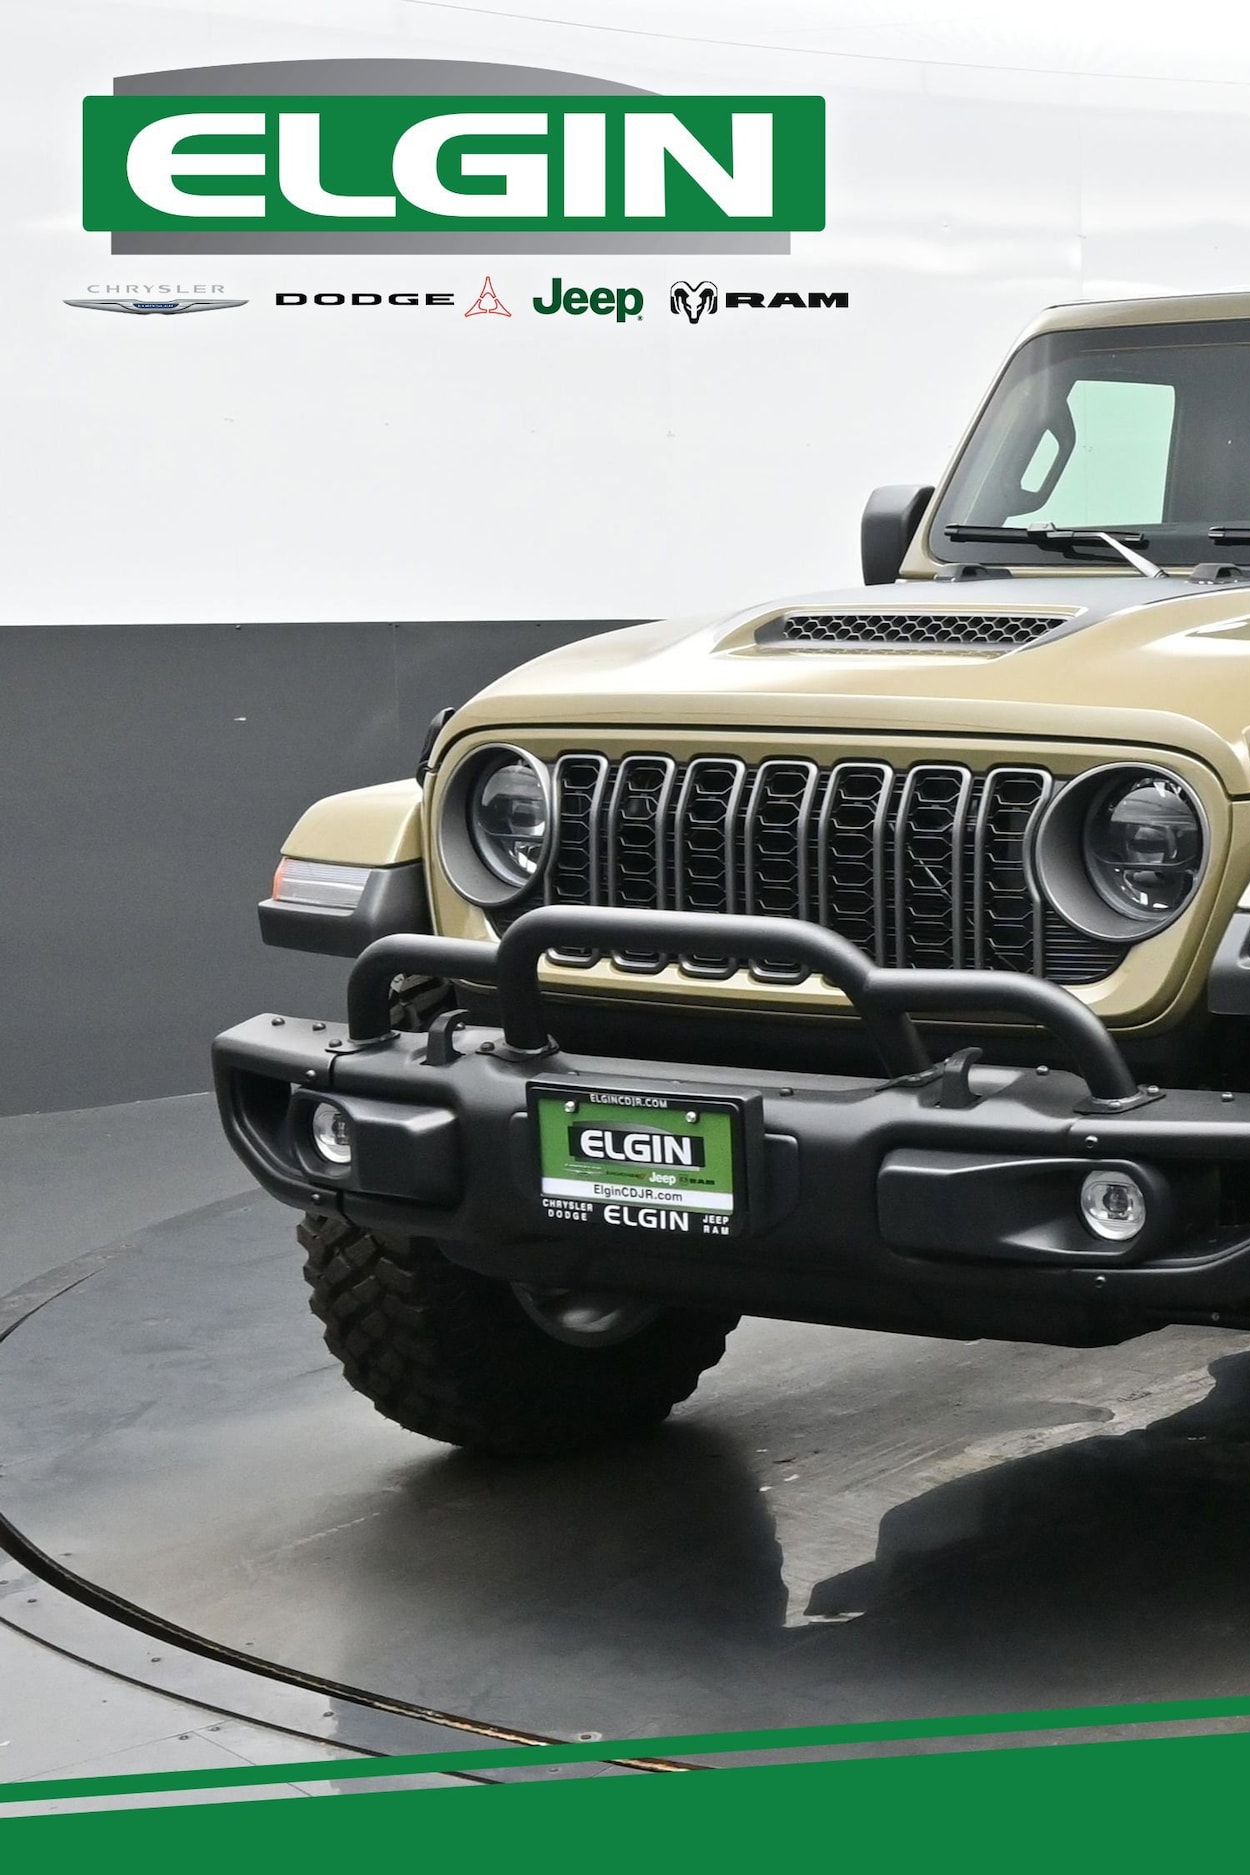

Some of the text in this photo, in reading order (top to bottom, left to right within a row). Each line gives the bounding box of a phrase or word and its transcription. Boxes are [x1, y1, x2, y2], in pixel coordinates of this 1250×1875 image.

[589, 1093, 668, 1109] ELGINCDJR.COM
[580, 1129, 693, 1166] ELGIN
[648, 1171, 677, 1186] Jeep
[593, 1183, 683, 1202] ElginCDJR.com
[542, 1198, 594, 1212] CHRYSLER
[547, 1209, 588, 1222] DODGE
[603, 1204, 690, 1232] ELGIN
[702, 1214, 730, 1226] JEEP
[702, 1224, 730, 1236] RAM
